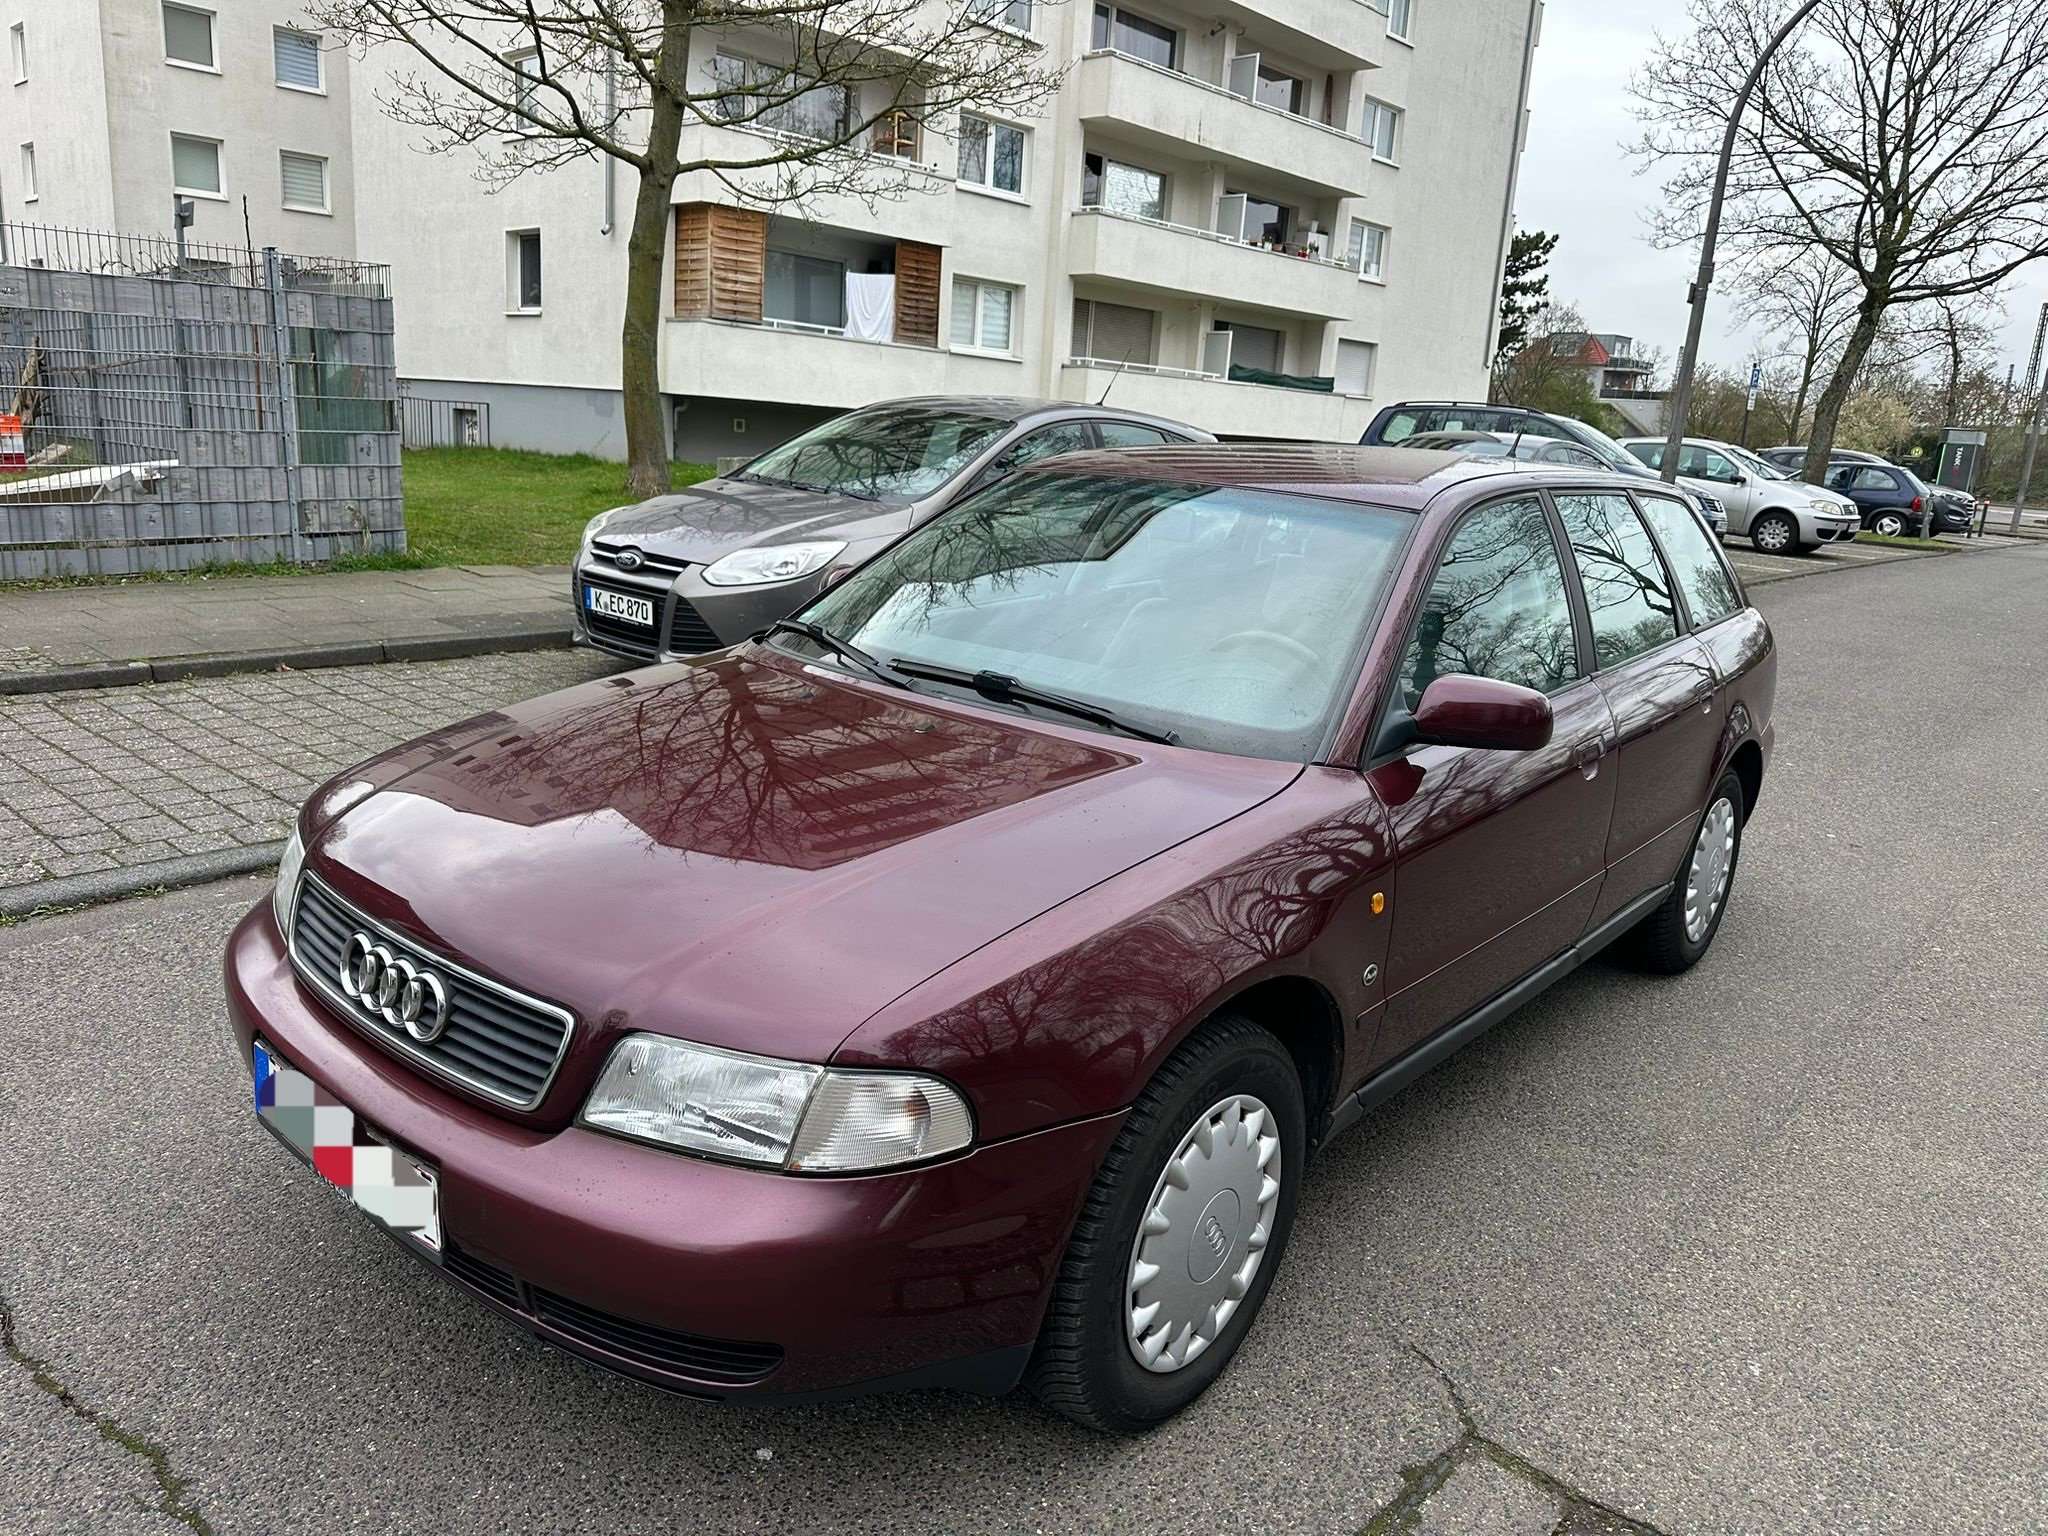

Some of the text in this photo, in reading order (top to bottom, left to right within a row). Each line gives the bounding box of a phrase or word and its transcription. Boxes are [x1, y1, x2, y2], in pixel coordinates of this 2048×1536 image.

[594, 591, 603, 610] K
[610, 594, 625, 615] EC
[627, 599, 649, 621] 870
